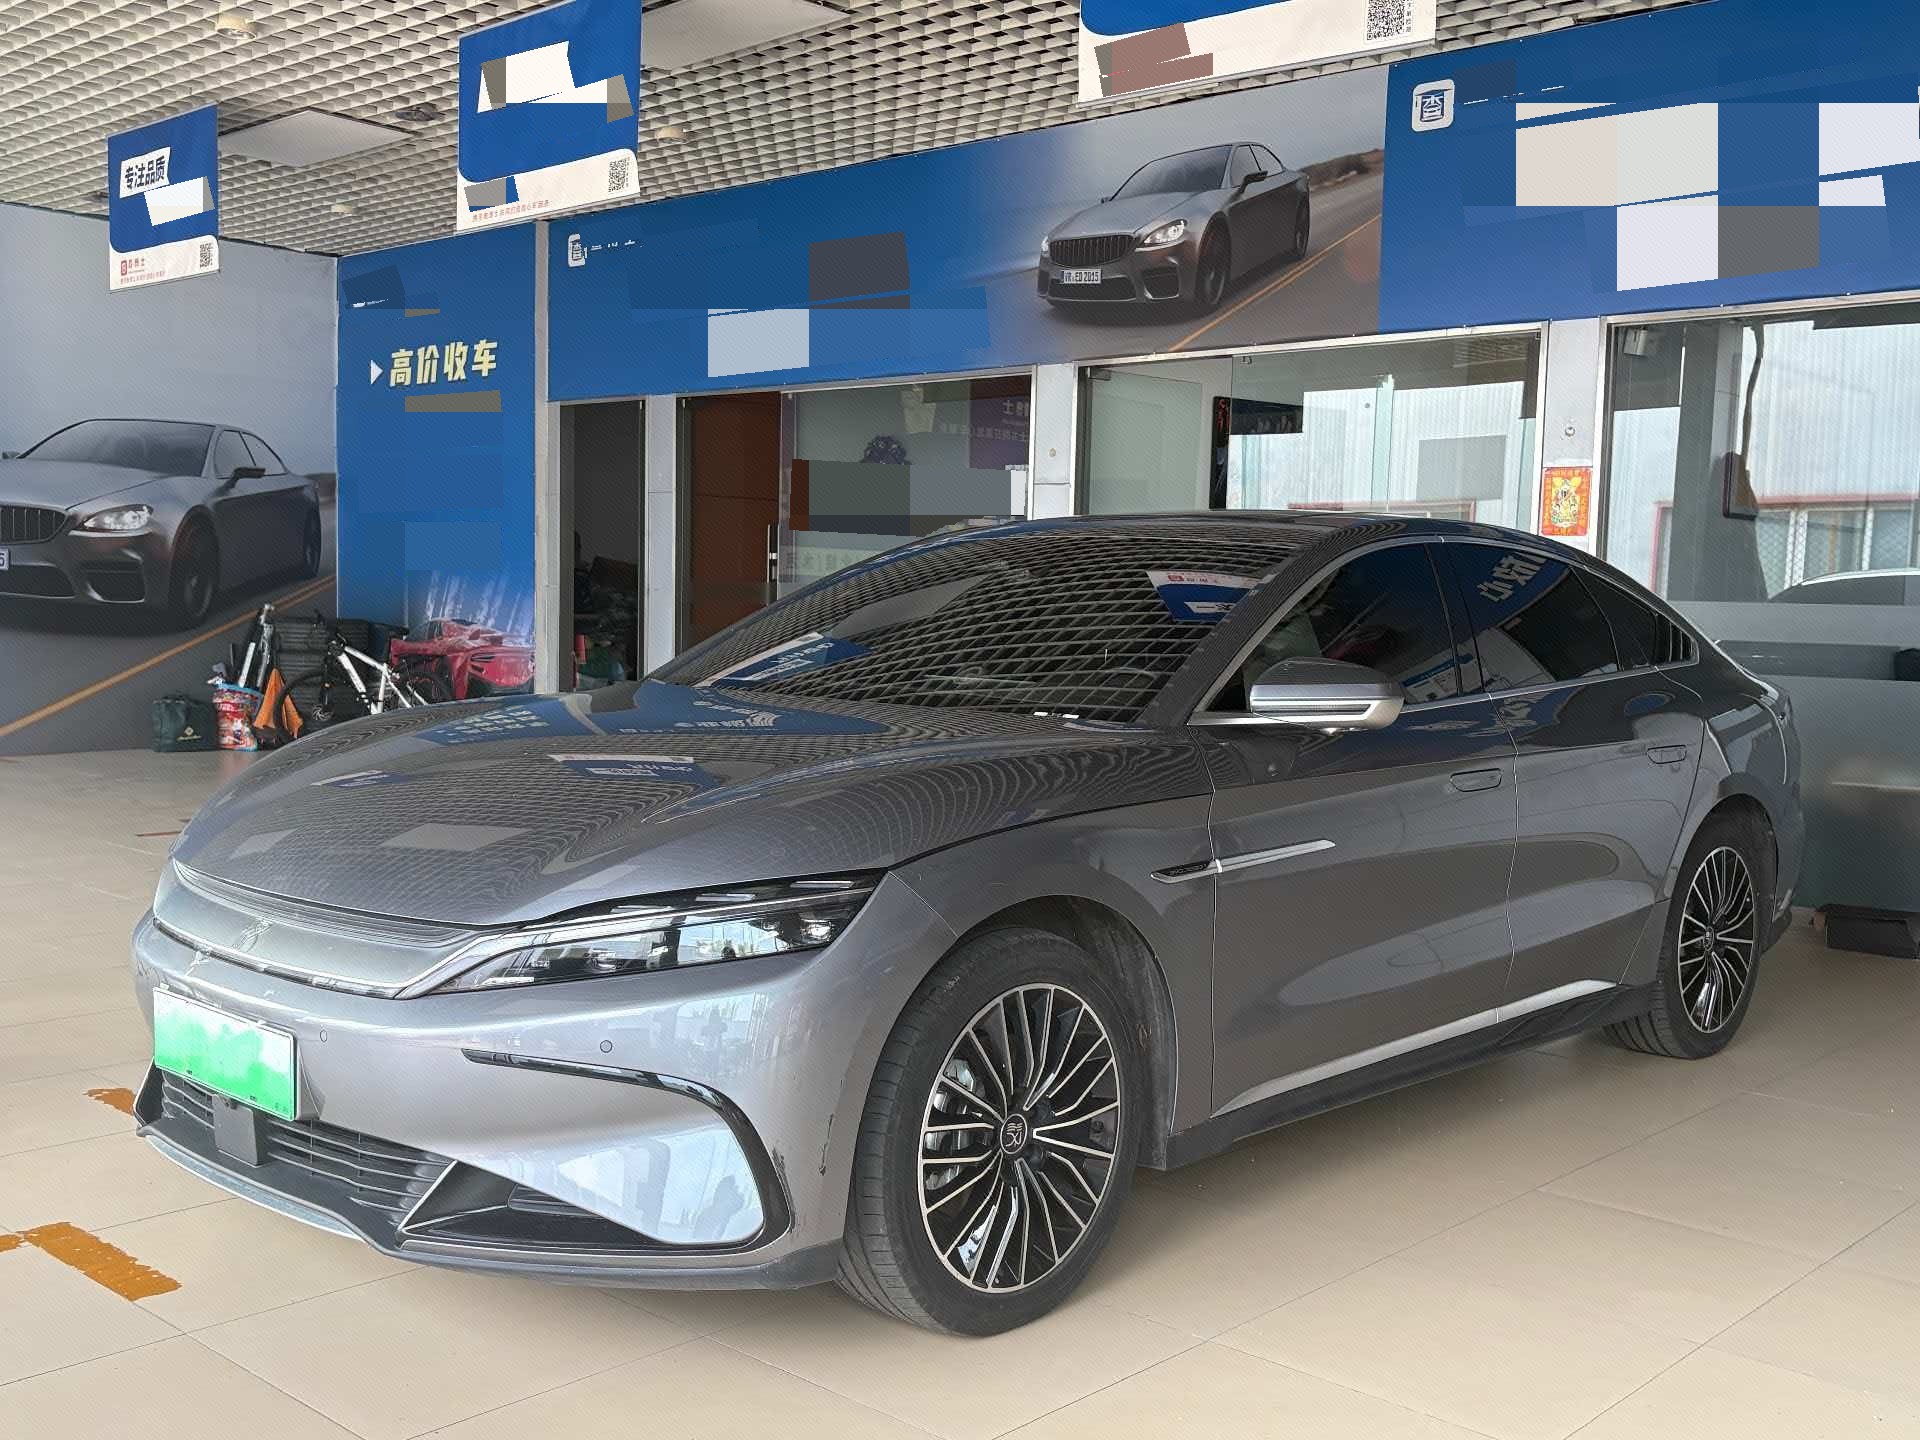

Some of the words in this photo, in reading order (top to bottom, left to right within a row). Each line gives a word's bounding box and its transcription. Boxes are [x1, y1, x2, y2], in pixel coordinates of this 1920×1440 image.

[125, 155, 165, 190] 专注品质
[390, 339, 498, 387] 高价收车
